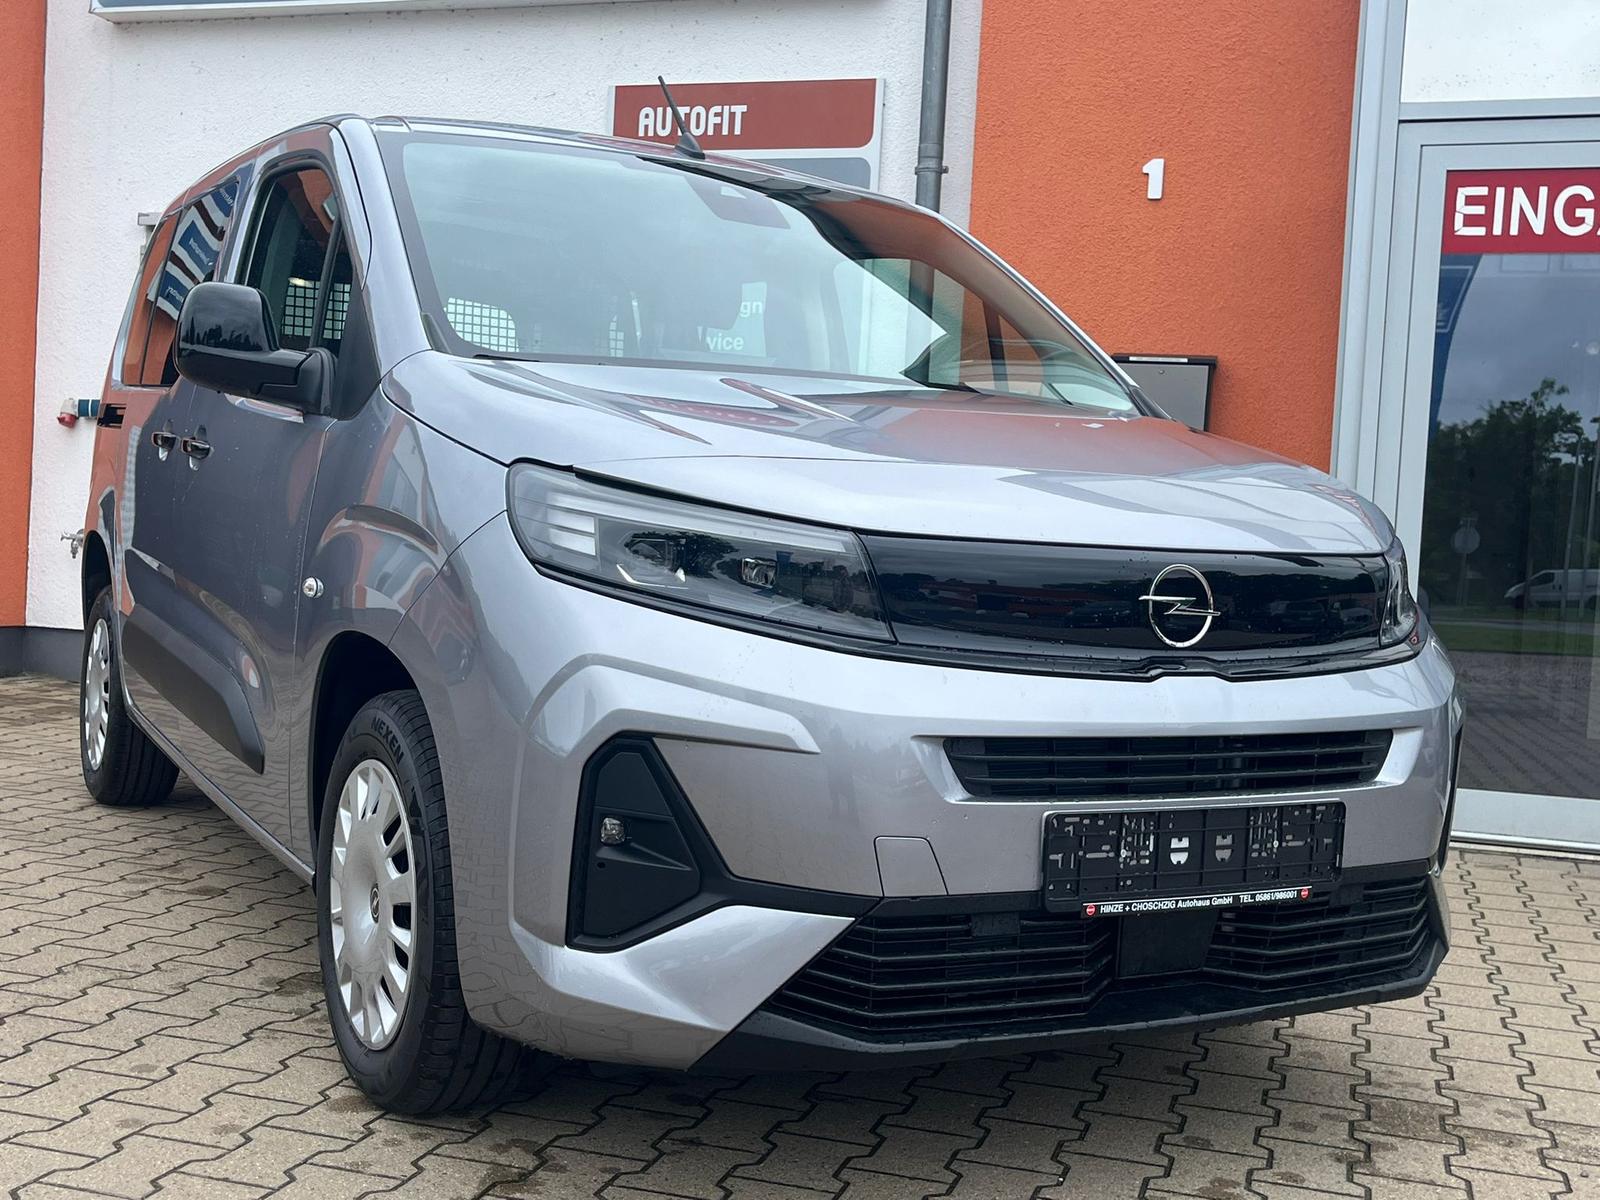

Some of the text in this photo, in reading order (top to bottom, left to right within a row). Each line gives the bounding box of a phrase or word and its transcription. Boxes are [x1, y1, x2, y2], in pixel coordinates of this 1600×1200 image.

[1142, 158, 1164, 199] 1
[1454, 185, 1600, 237] EING
[371, 716, 404, 764] NEXEN
[1100, 903, 1124, 914] HINZE
[1177, 898, 1210, 908] Autohaus
[1211, 896, 1233, 906] GmbH
